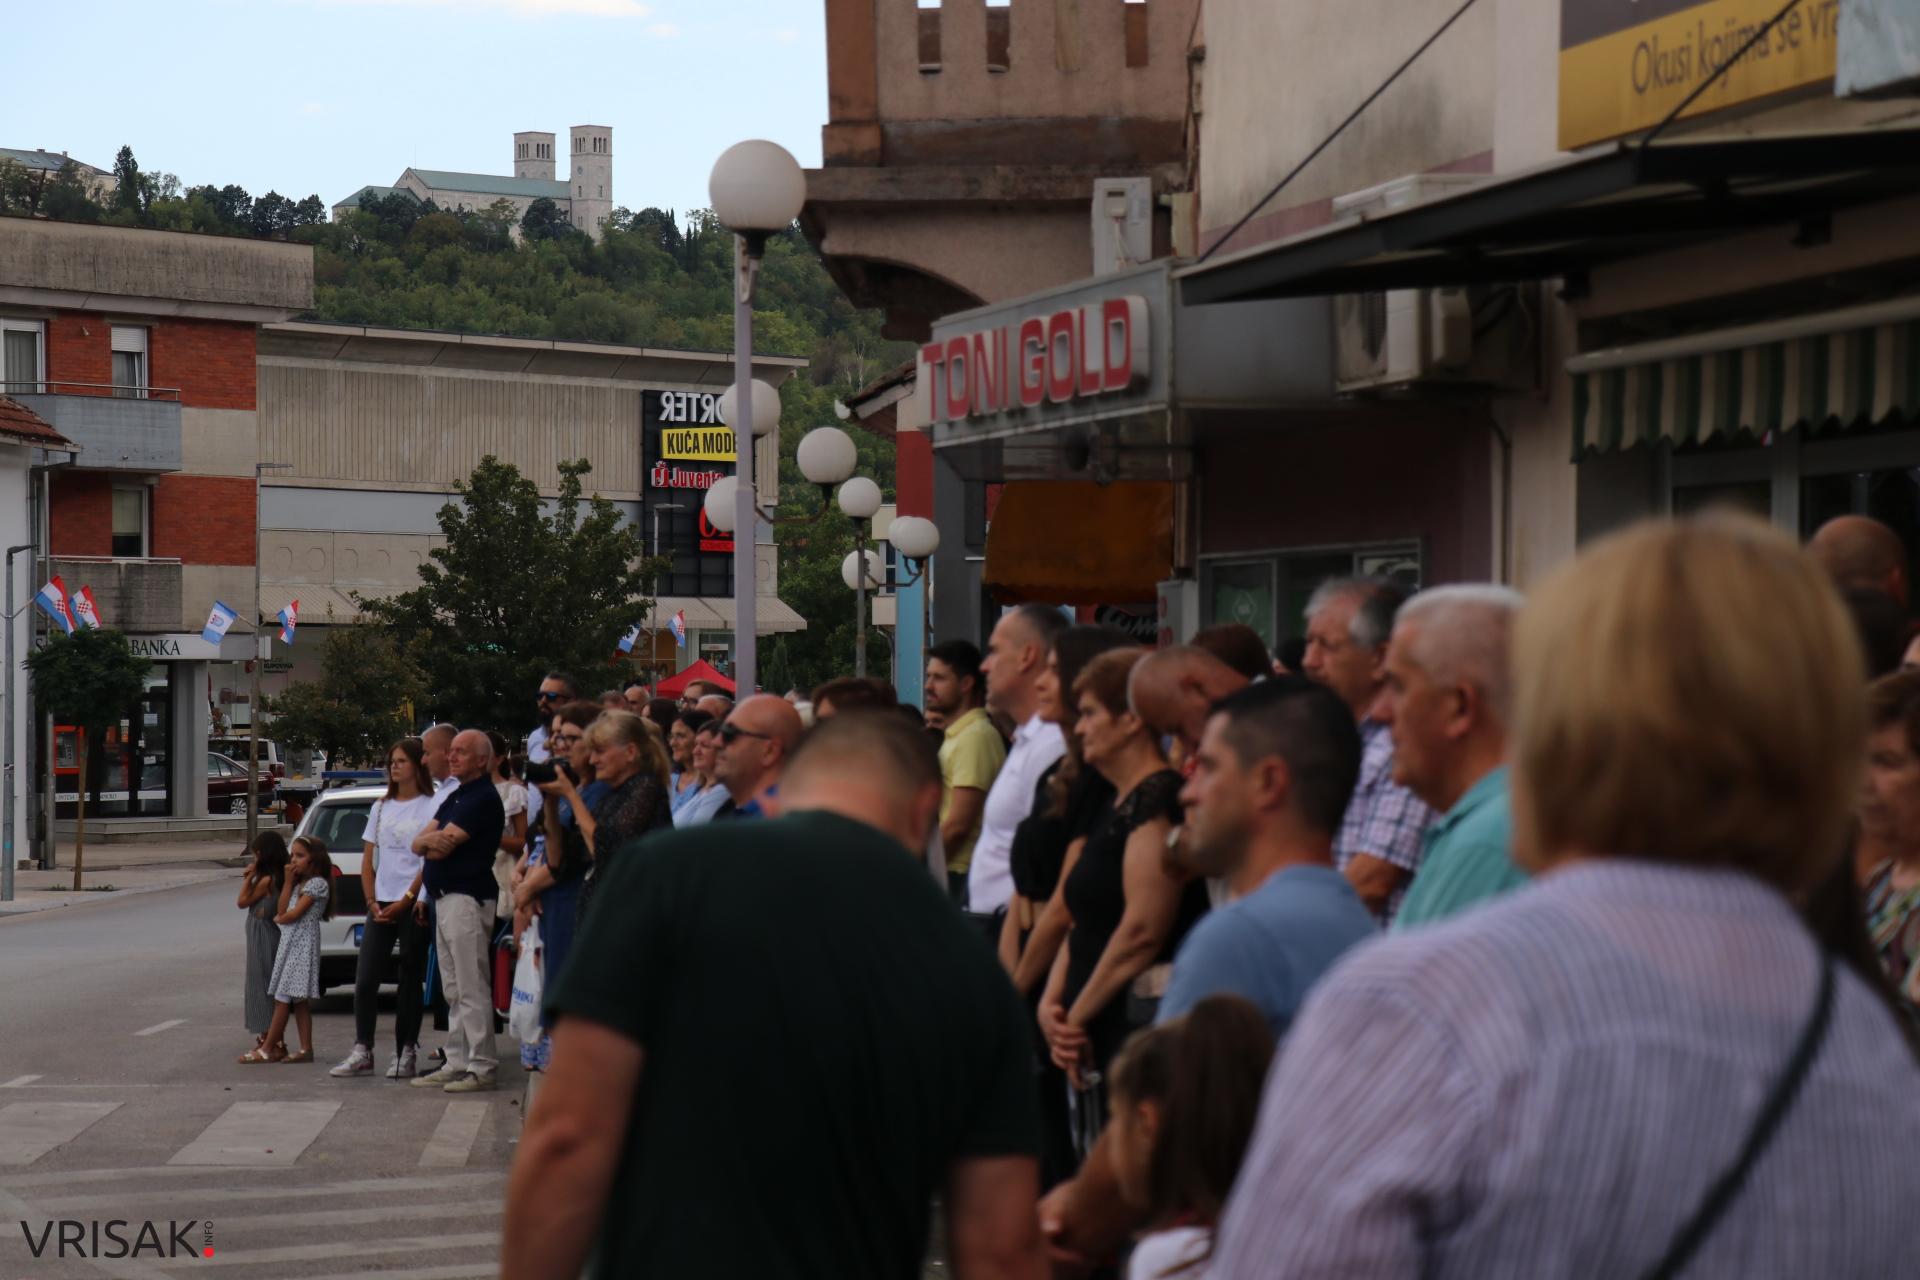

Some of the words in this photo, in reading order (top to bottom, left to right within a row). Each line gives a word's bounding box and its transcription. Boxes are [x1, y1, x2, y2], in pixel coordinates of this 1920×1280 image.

[1632, 32, 1692, 95] Okusi
[920, 325, 1010, 422] TONI
[1019, 297, 1138, 408] GOLD
[667, 430, 701, 454] KUĆA
[131, 639, 181, 656] BANKA
